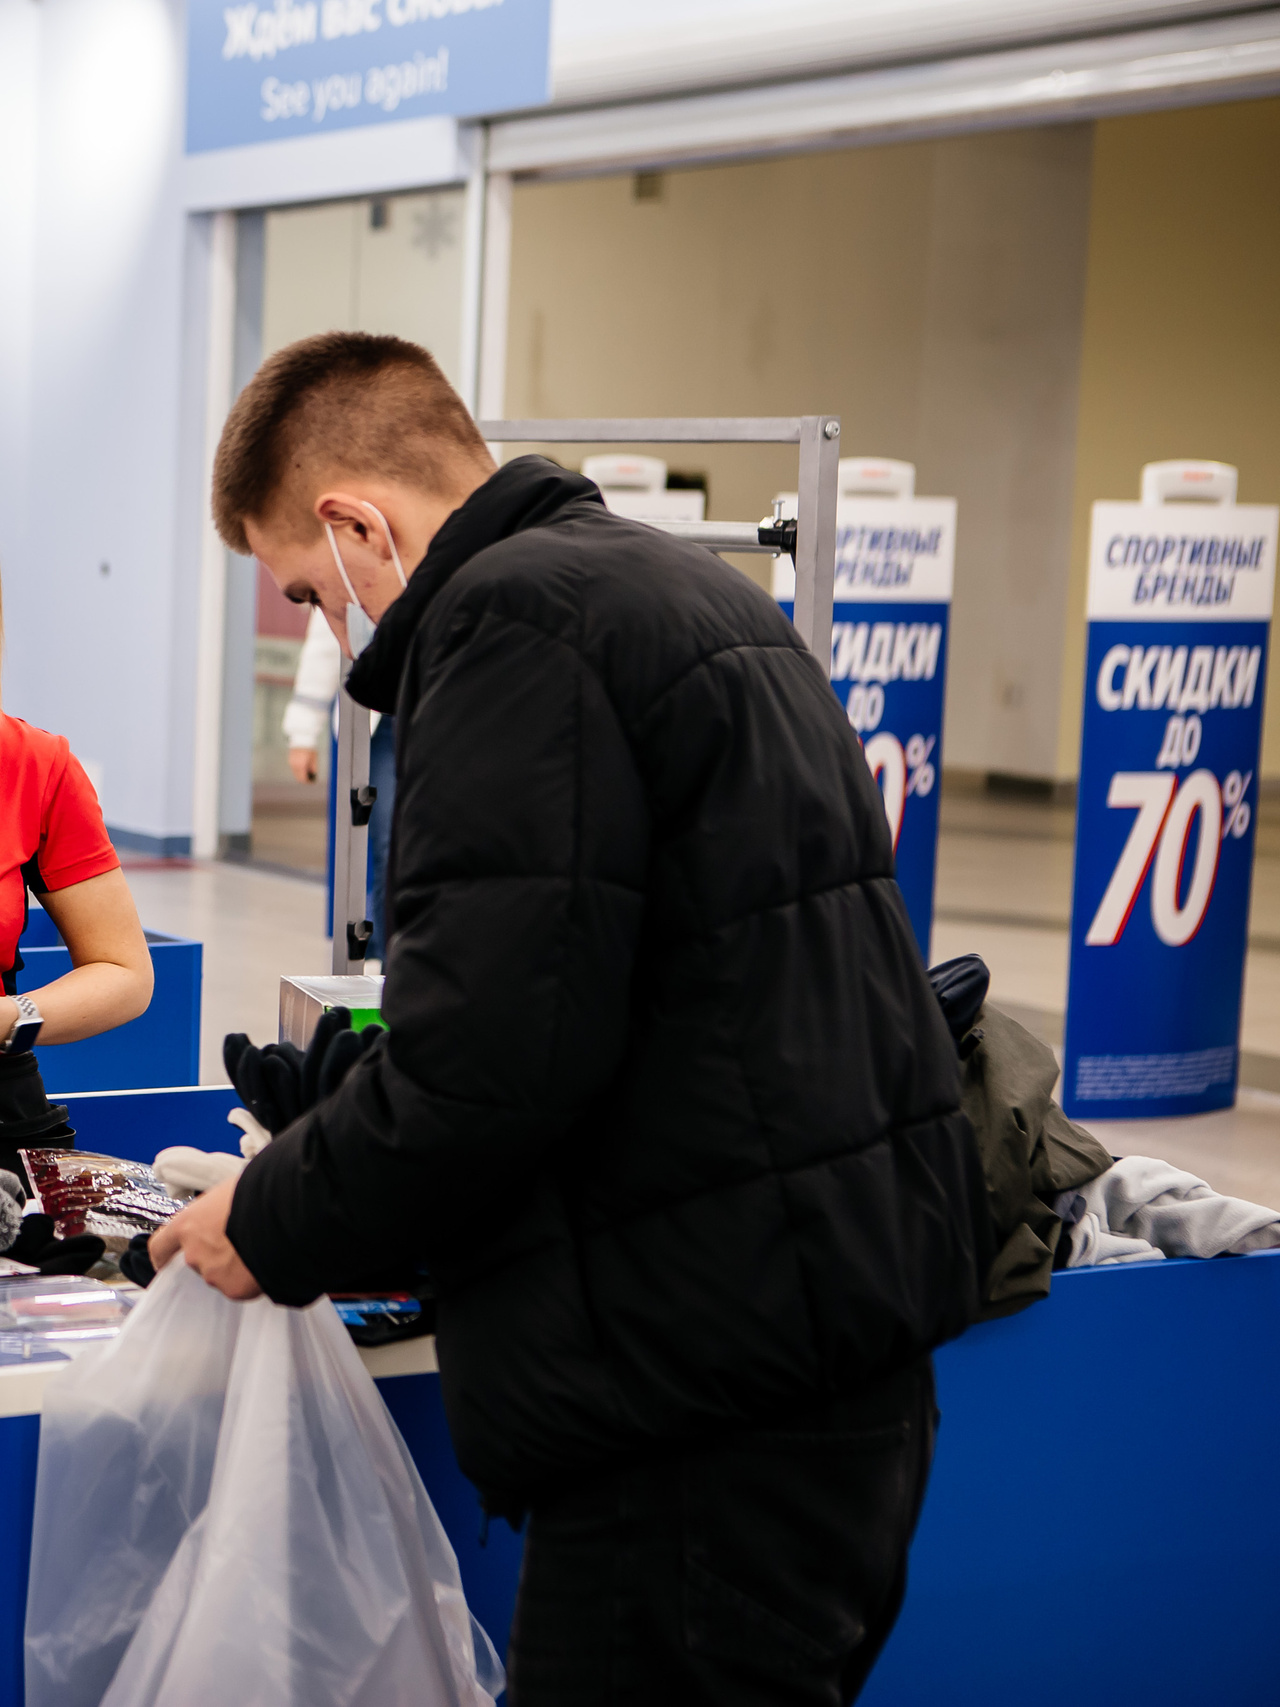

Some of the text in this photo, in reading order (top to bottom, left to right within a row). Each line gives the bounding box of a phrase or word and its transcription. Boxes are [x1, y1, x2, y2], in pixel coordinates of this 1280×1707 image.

[260, 45, 449, 122] See you again!
[834, 559, 915, 588] РЕНДЫ
[1105, 533, 1266, 570] СПОРТИВНЫЕ
[1132, 571, 1237, 607] БРЕНДЫ
[1096, 643, 1262, 714] СКИДКИ
[1156, 713, 1203, 769] ДО
[1085, 768, 1253, 947] 70%
